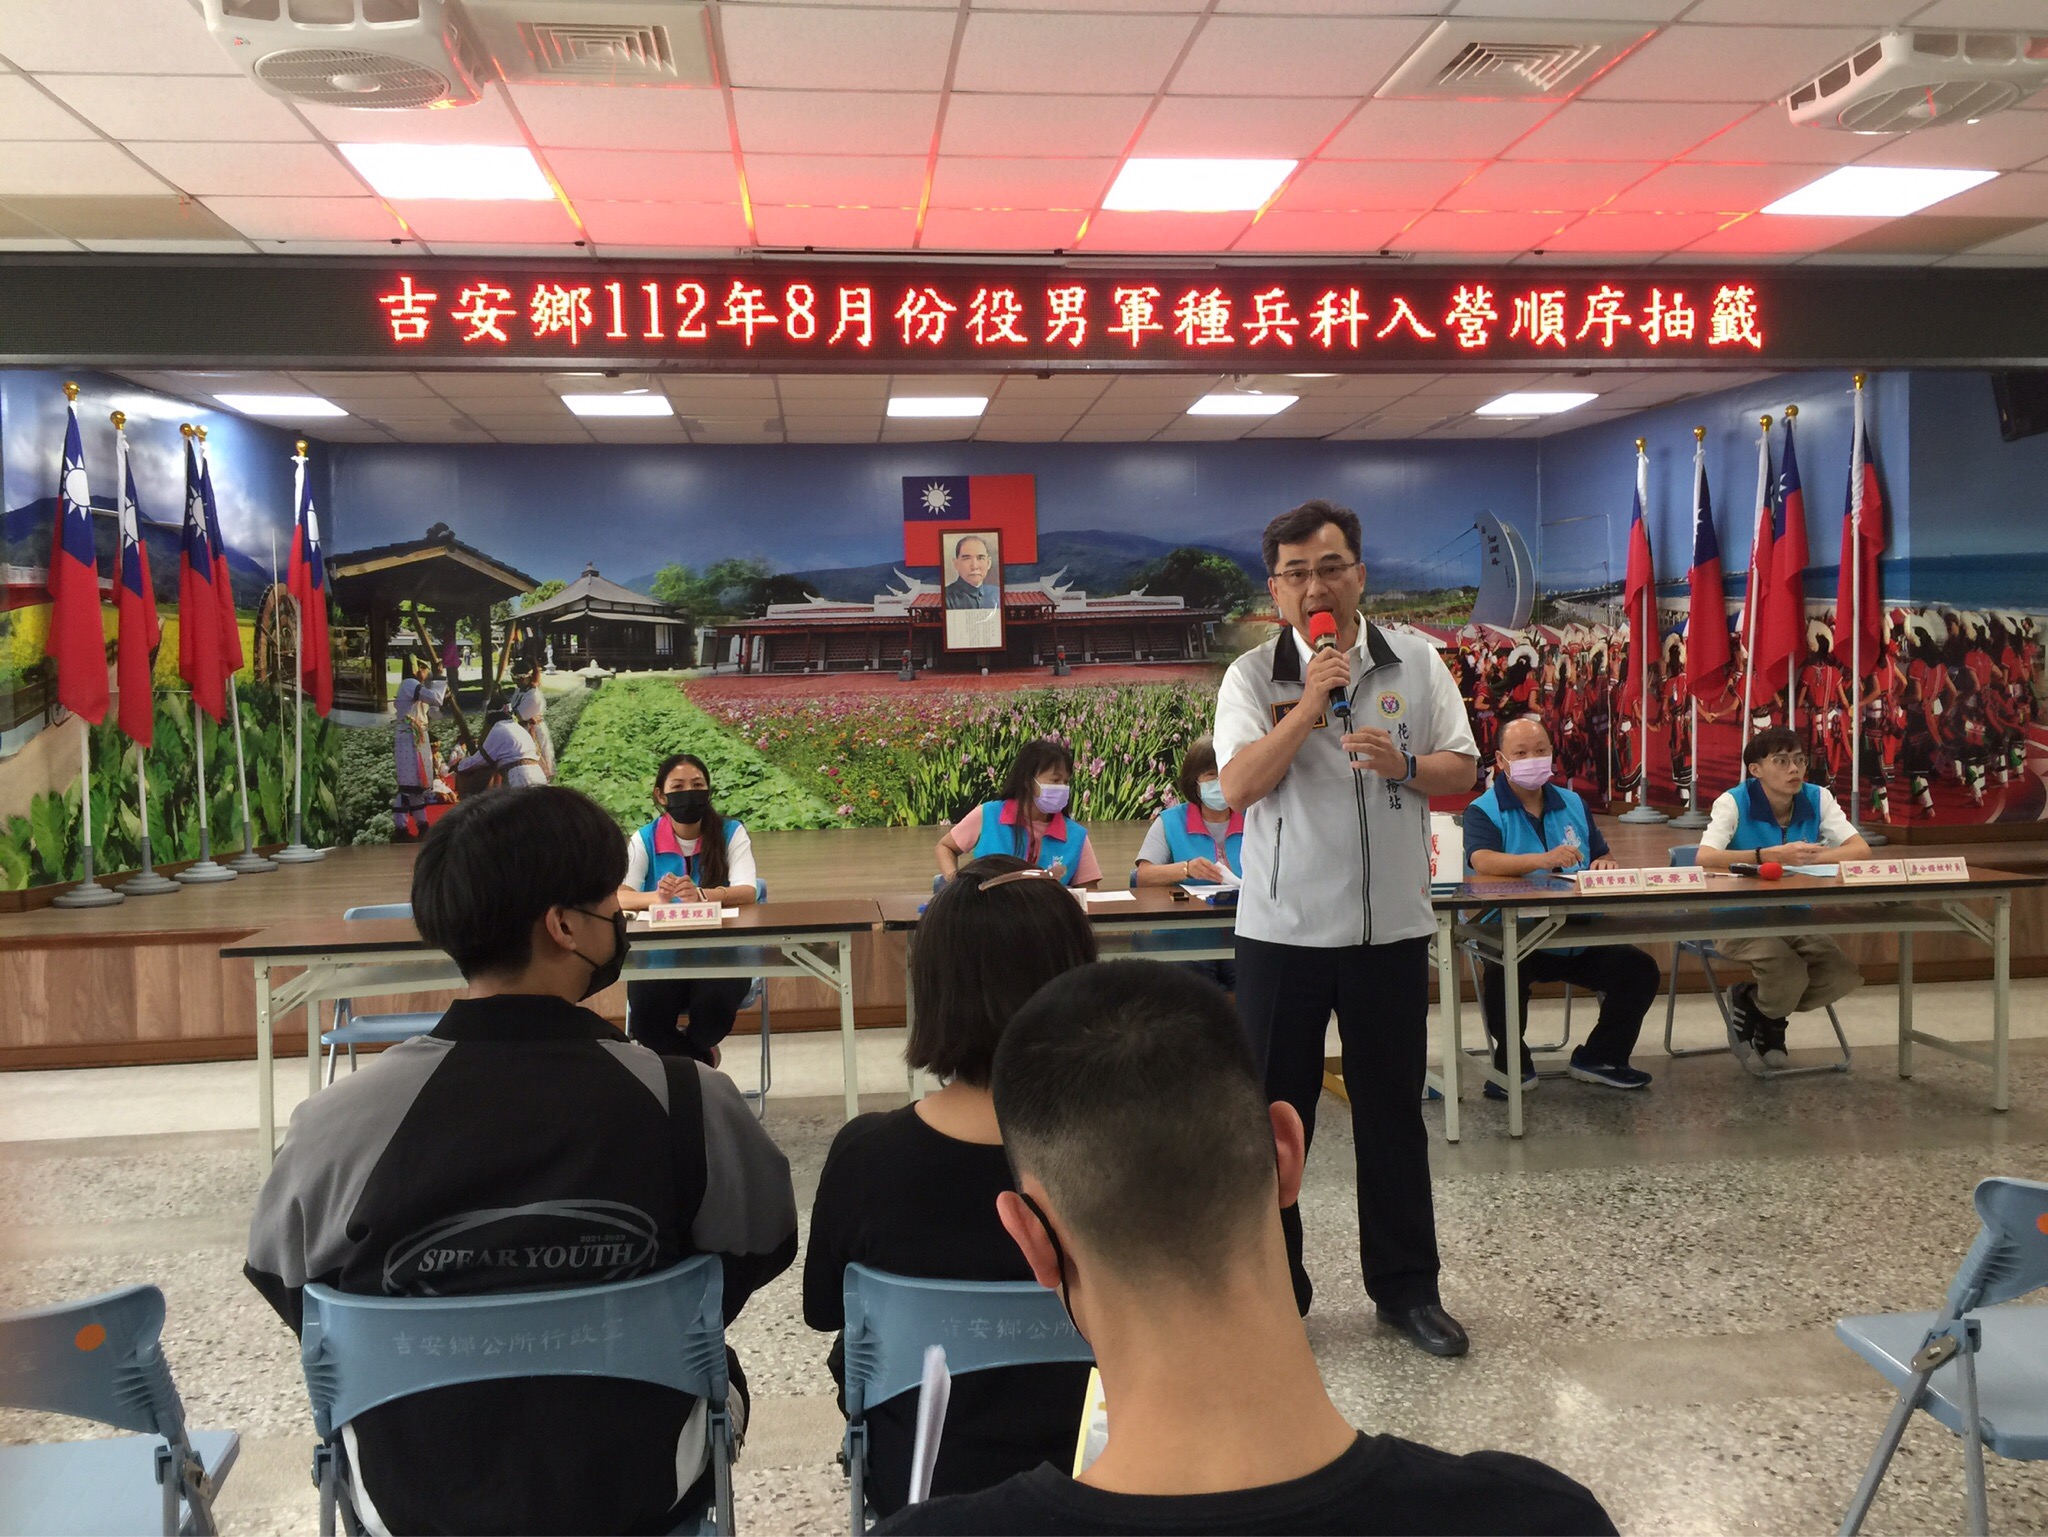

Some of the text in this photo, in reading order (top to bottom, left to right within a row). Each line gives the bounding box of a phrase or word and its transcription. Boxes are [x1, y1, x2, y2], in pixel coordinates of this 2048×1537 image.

[379, 276, 1763, 348] 吉安鄉112年8月份役男軍種兵科入營順序抽籤
[1847, 865, 1899, 875] 唱名員
[525, 1243, 635, 1269] YOUTH
